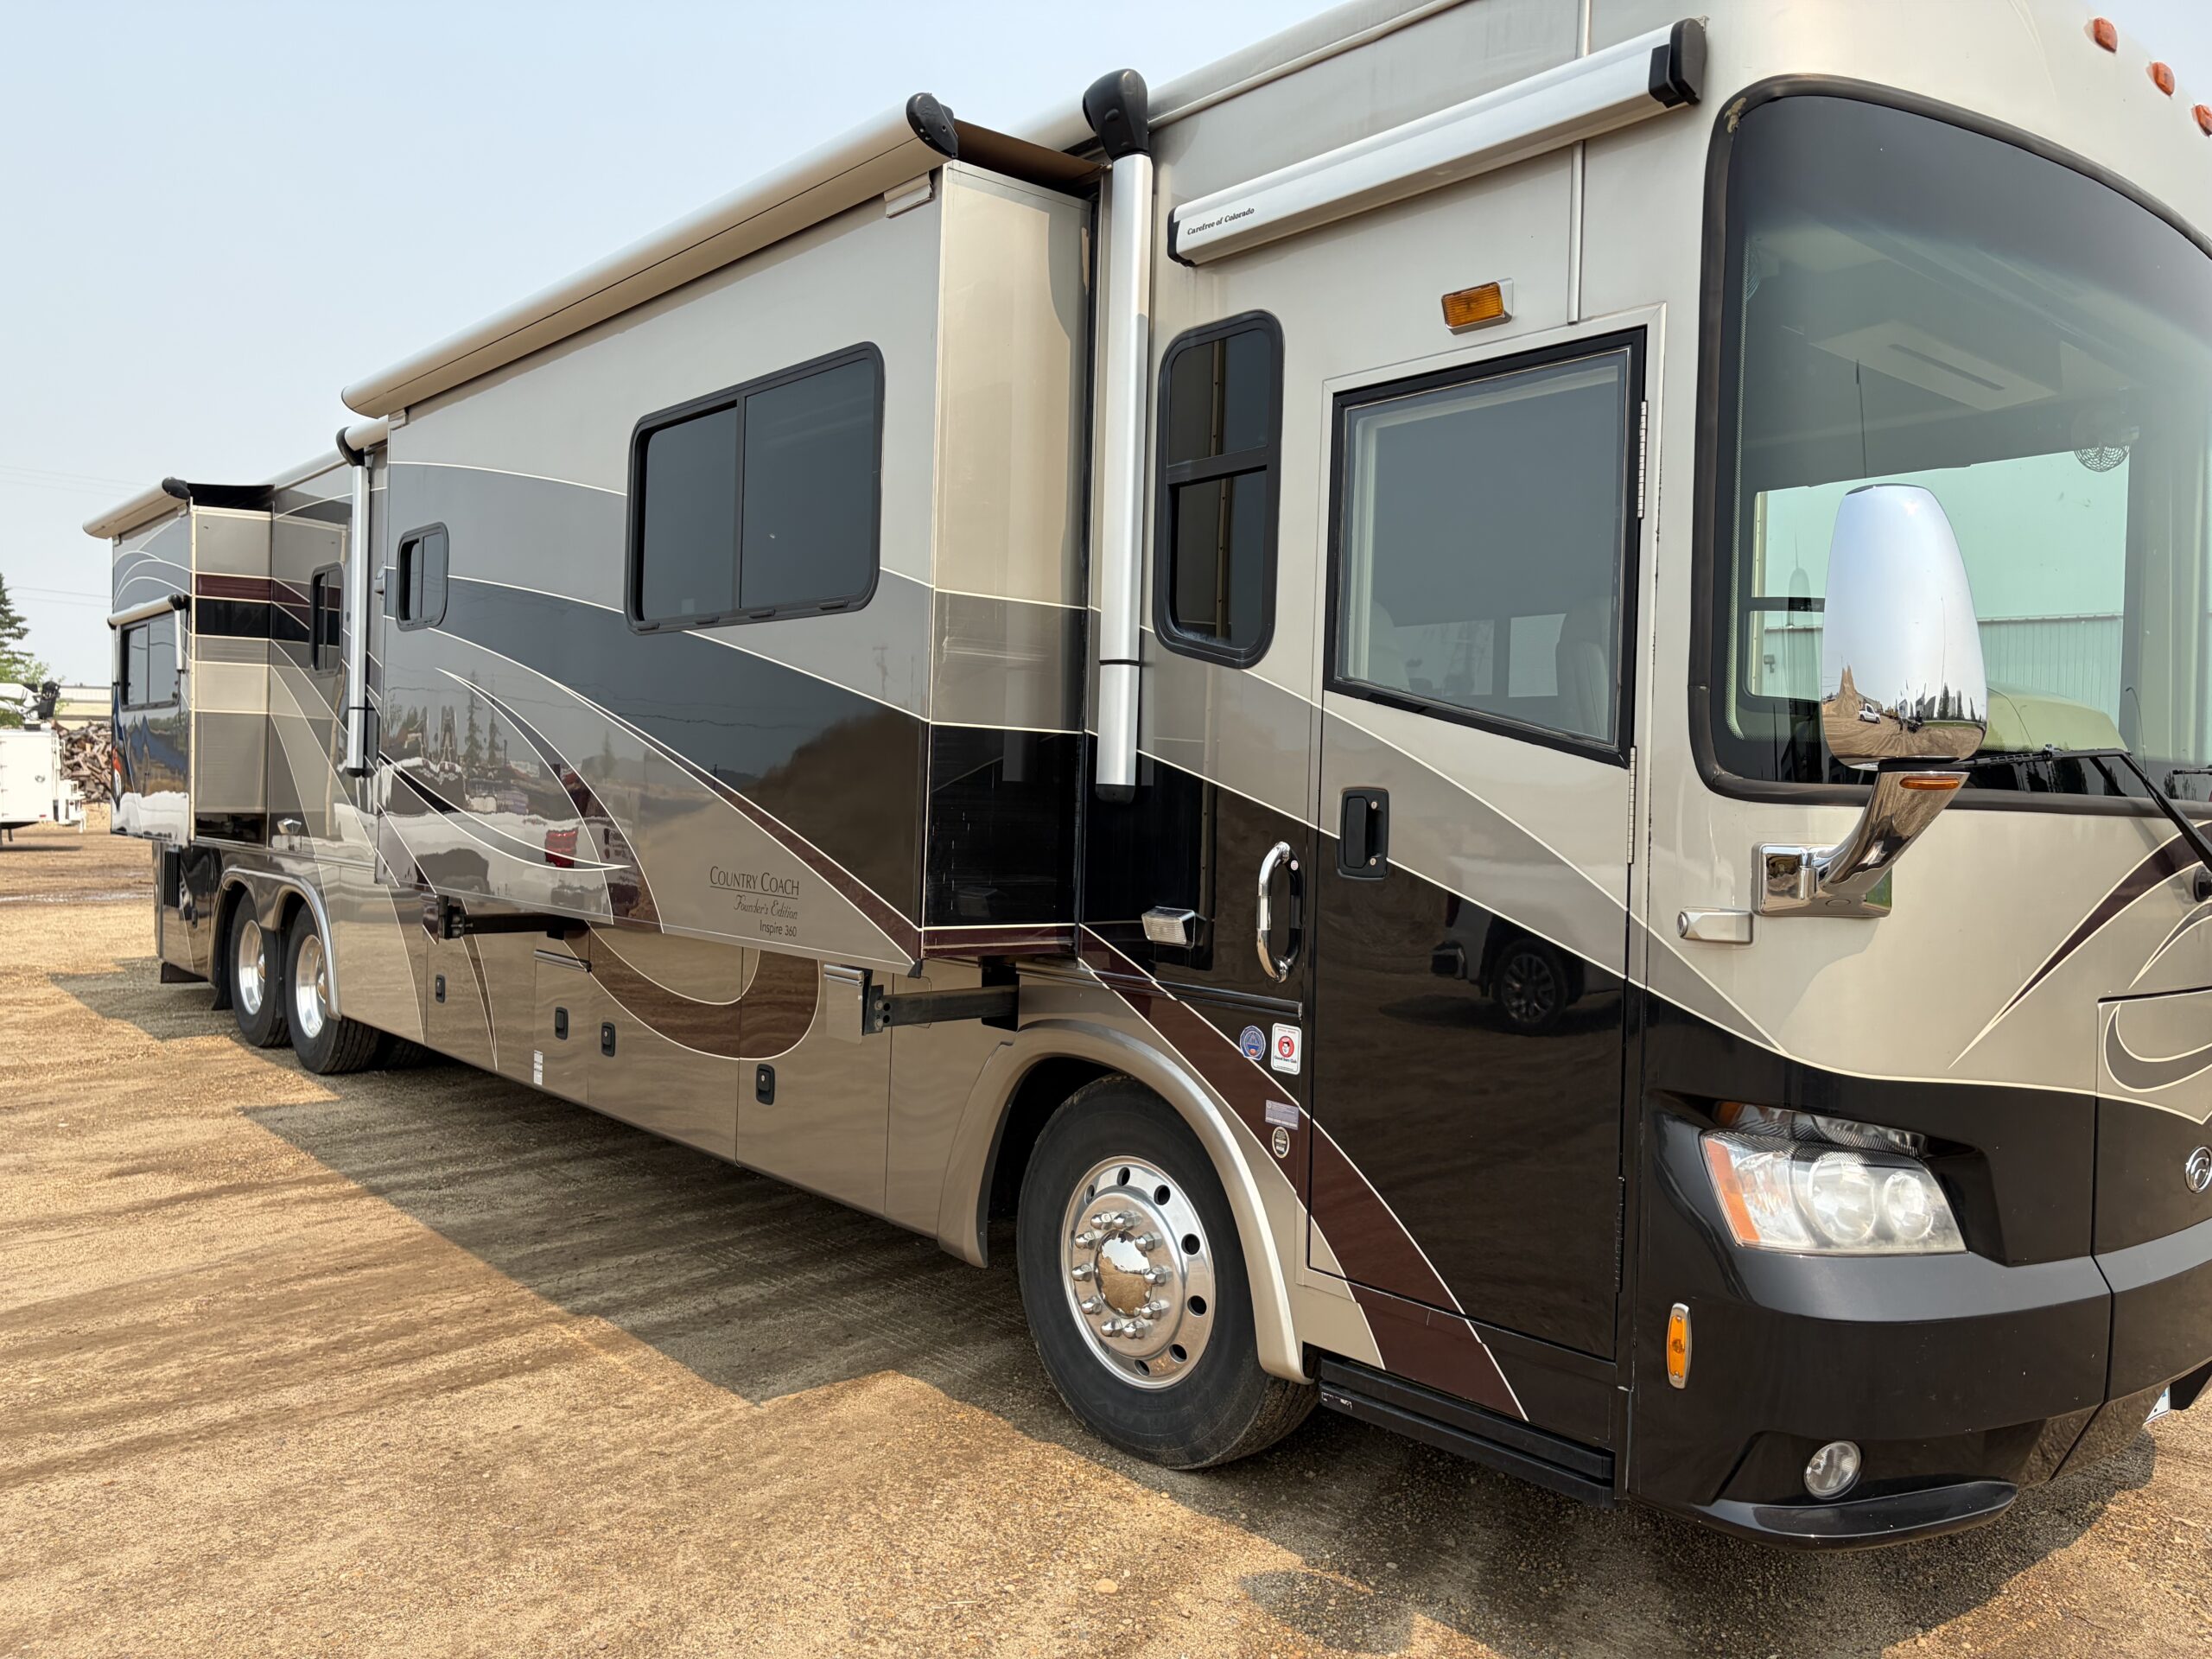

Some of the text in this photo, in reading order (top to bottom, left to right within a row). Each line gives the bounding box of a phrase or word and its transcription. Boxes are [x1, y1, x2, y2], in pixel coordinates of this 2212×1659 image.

[1187, 221, 1215, 235] Carefree
[1224, 207, 1255, 222] Colorado
[710, 866, 799, 895] COUNTRY COACH
[734, 894, 798, 919] Founder's Edition
[760, 919, 797, 937] Inspire 360
